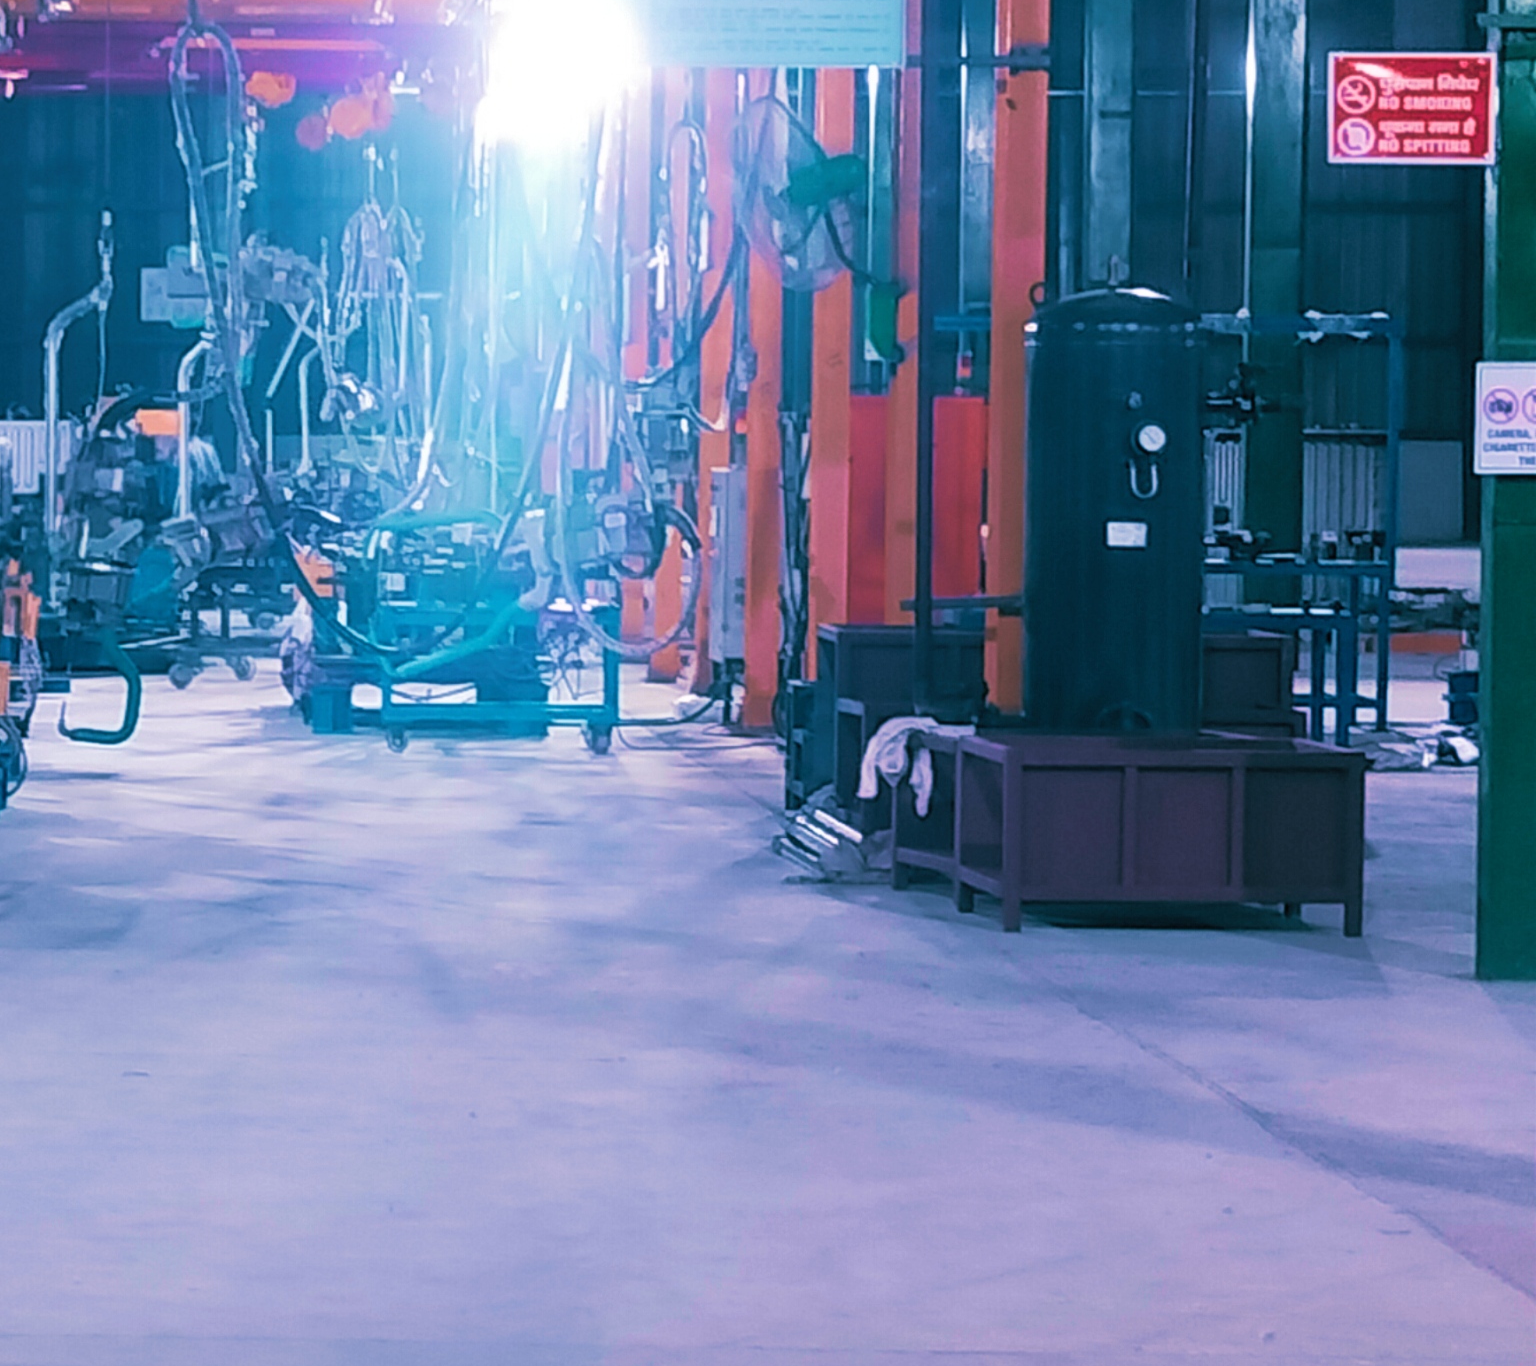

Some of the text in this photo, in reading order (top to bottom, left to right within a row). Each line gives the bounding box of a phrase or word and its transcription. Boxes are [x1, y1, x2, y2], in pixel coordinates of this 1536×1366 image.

[1378, 96, 1472, 111] NO SMOKING
[1378, 139, 1471, 153] NO SPITTING
